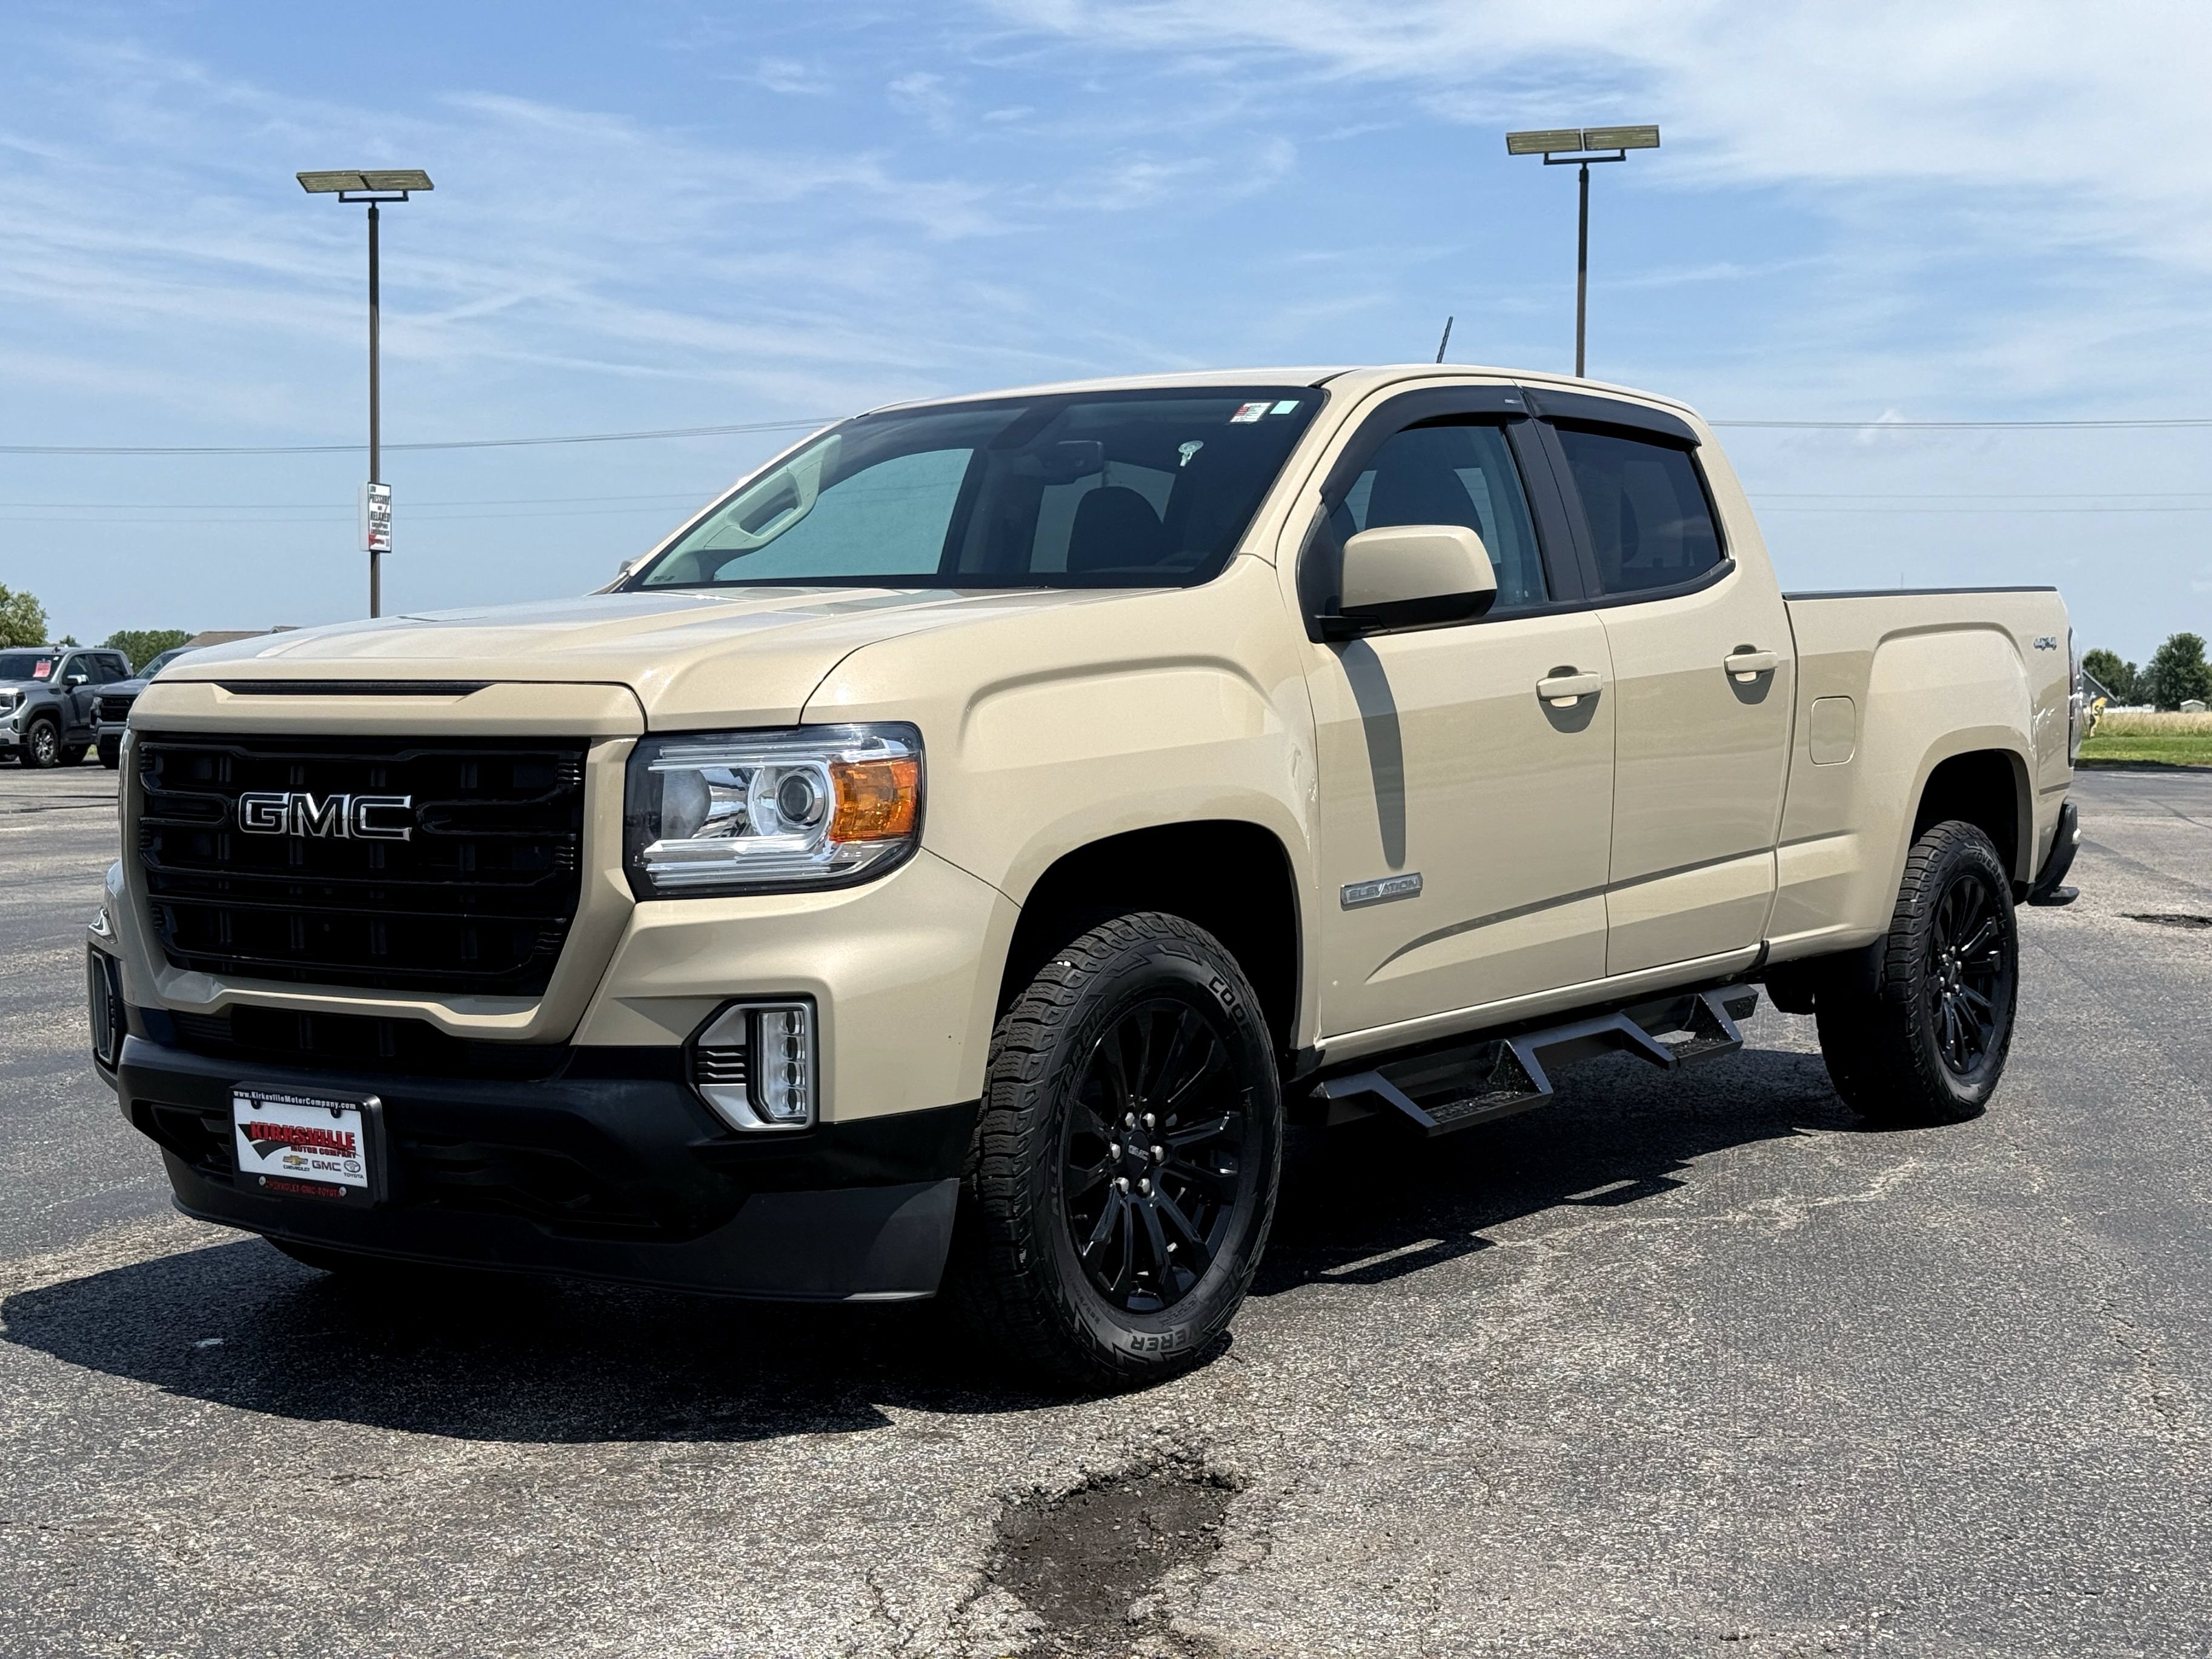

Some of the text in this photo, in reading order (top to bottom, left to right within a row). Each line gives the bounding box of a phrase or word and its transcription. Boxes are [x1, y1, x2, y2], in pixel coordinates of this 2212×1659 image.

[239, 792, 413, 842] GMC
[1347, 878, 1420, 902] ELEVATION
[249, 1121, 356, 1150] KIRKSVILLE
[291, 1145, 356, 1159] MOTOR COMPANY
[1127, 1143, 1149, 1161] GMC
[312, 1160, 342, 1172] GMC
